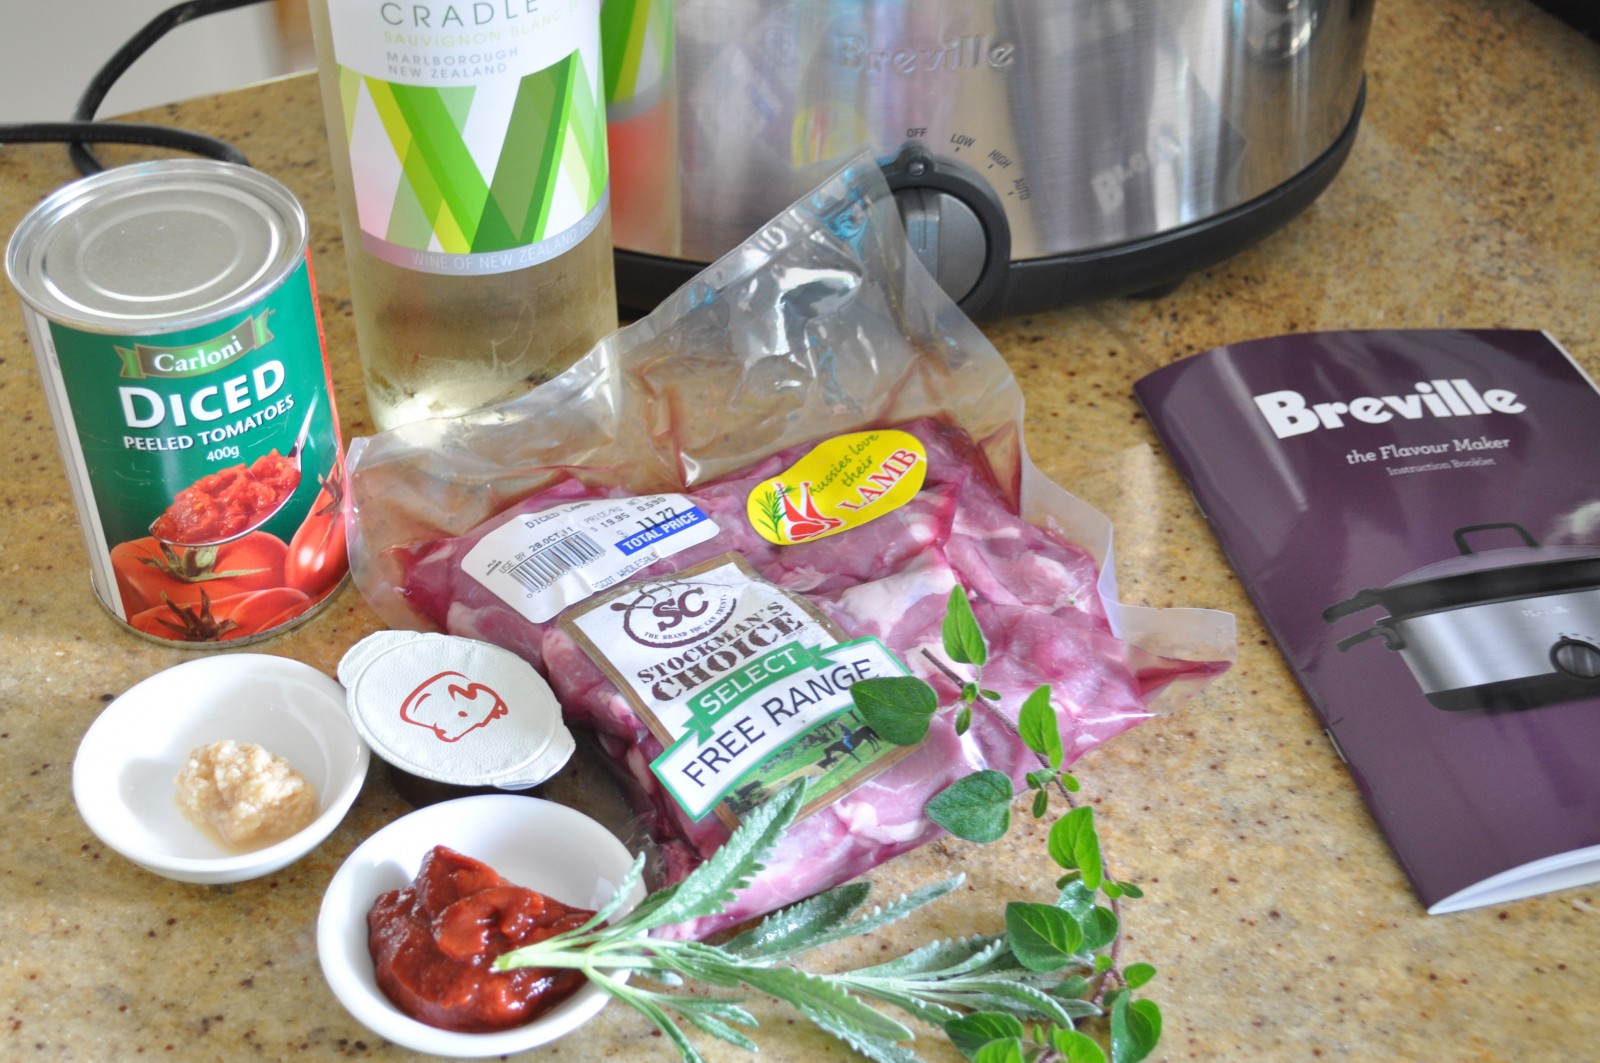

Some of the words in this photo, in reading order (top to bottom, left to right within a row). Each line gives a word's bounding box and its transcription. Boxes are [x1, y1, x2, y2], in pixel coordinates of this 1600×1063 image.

[380, 0, 539, 28] CRADLE
[384, 31, 501, 47] SAUVIGNON
[510, 8, 562, 38] BLANC
[386, 47, 518, 66] MARLBOROUGH
[388, 64, 421, 78] NEW
[431, 63, 508, 79] ZEALAND
[832, 34, 1016, 74] Breville
[906, 127, 928, 138] OFF
[950, 133, 976, 148] LOW
[987, 149, 1012, 169] HIGH
[1013, 178, 1031, 201] AUTO
[411, 252, 448, 270] WINE
[454, 256, 473, 270] OF
[479, 253, 513, 270] NEW
[519, 229, 577, 264] ZEALAND
[154, 335, 244, 372] Carloni
[118, 360, 285, 429] DICED
[1253, 378, 1527, 439] Breville
[123, 435, 194, 451] PEELED
[197, 394, 295, 445] TOMATOES
[206, 445, 240, 462] 400g
[808, 455, 852, 496] Aussies
[848, 432, 880, 455] love
[1346, 449, 1378, 465] the
[1379, 443, 1450, 460] Flavour
[1452, 436, 1511, 452] Maker
[837, 449, 919, 512] LAMB
[841, 455, 874, 488] their
[1386, 462, 1452, 476] Instruction
[525, 512, 560, 529] DICED
[600, 512, 630, 528] 19.95
[622, 531, 663, 550] TOTAL
[660, 511, 699, 533] PRICE
[498, 560, 514, 574] USE
[514, 551, 526, 561] BY
[652, 586, 709, 632] SC
[637, 601, 785, 684] STOCKMAN'S
[644, 631, 659, 640] THE
[662, 632, 688, 640] BRAND
[689, 625, 704, 633] YOU
[704, 616, 717, 626] CAN
[651, 611, 805, 701] CHOICE
[700, 648, 798, 716] SELECT
[682, 716, 766, 788] FREE
[761, 658, 880, 727] RANGE
